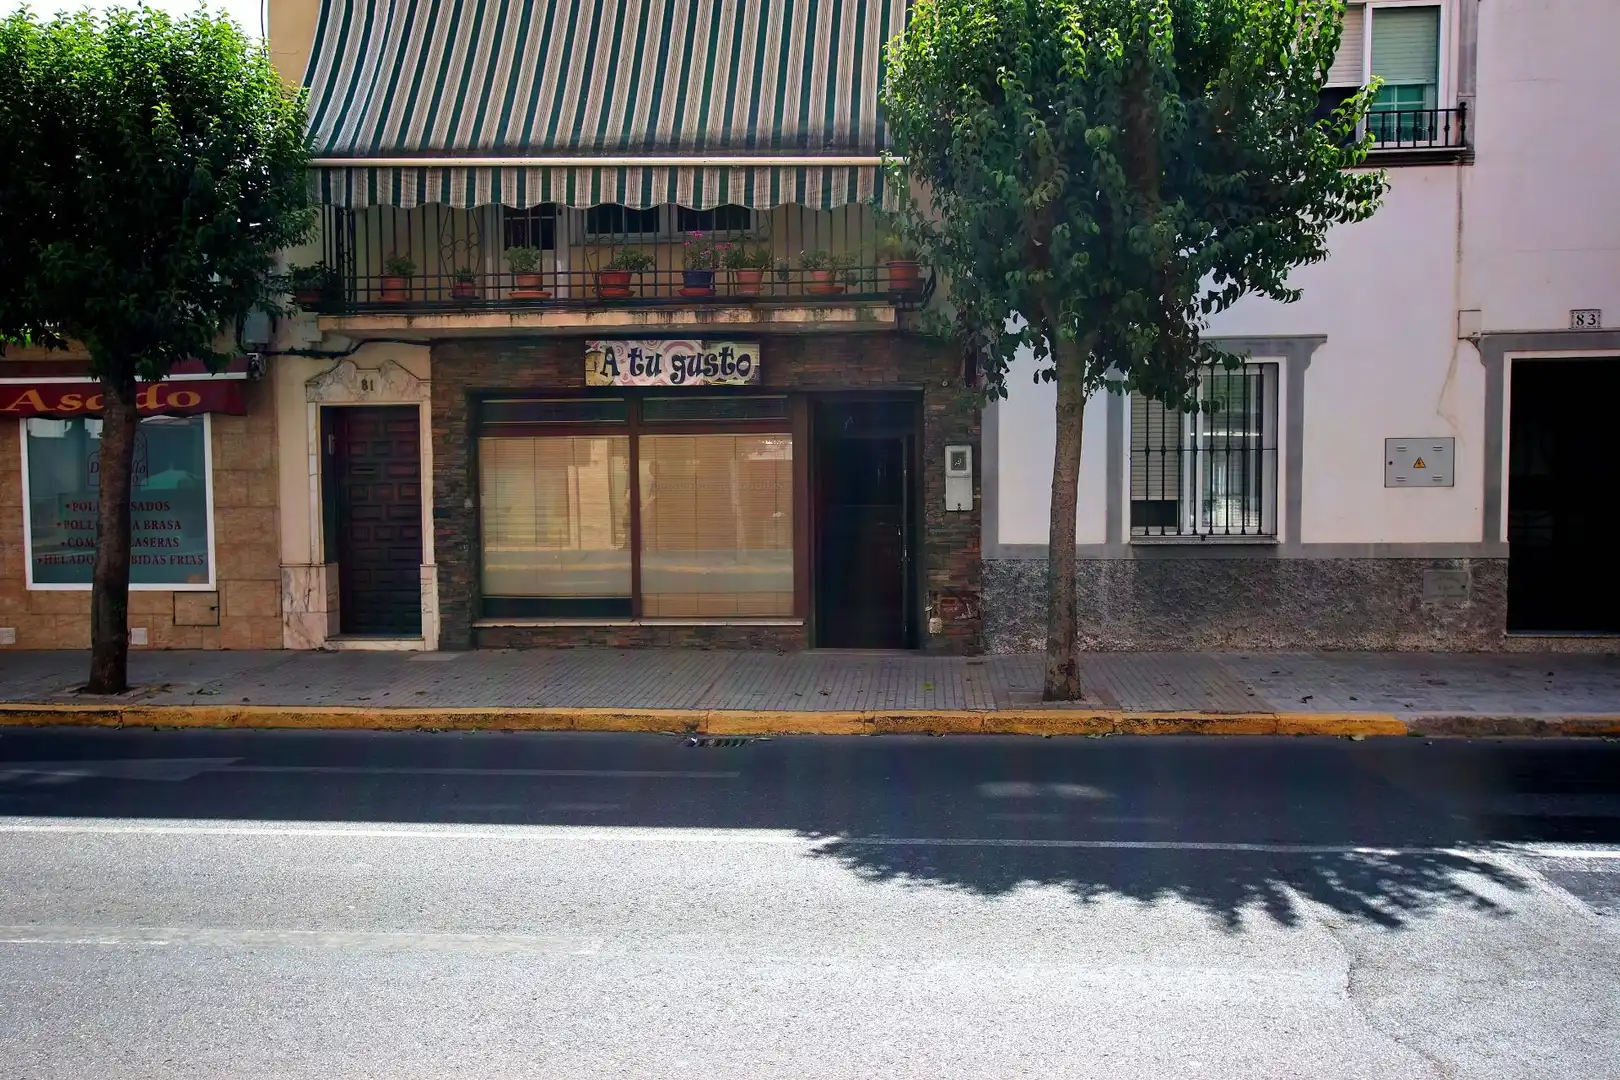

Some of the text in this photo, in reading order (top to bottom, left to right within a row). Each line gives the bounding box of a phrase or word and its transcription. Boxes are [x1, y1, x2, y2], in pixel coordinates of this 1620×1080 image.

[1576, 313, 1596, 326] 83
[600, 346, 751, 384] A tu gusto
[361, 379, 374, 391] 81
[129, 501, 171, 512] SADOS
[143, 520, 182, 530] BRASA
[130, 537, 180, 548] ASERAS
[44, 554, 95, 566] HELADO
